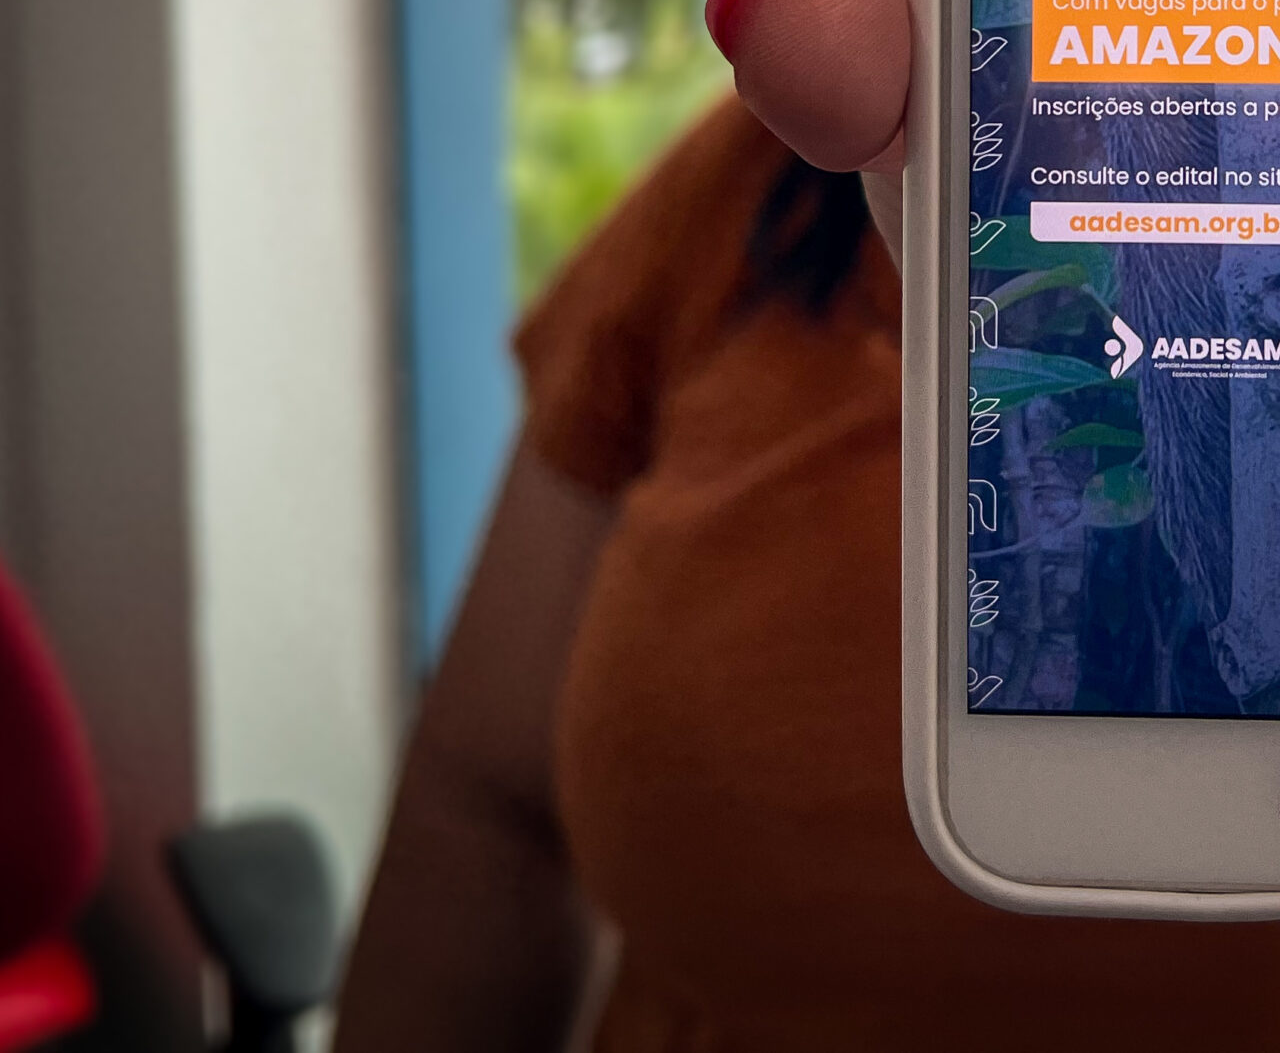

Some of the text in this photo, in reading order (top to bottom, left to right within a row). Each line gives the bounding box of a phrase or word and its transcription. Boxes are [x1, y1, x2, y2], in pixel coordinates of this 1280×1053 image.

[1032, 96, 1143, 120] Inscrições
[1150, 96, 1236, 116] abertas
[1243, 101, 1258, 116] a
[1030, 166, 1130, 186] Consulte
[1135, 170, 1150, 186] o
[1156, 166, 1218, 186] edital
[1225, 171, 1252, 186] no
